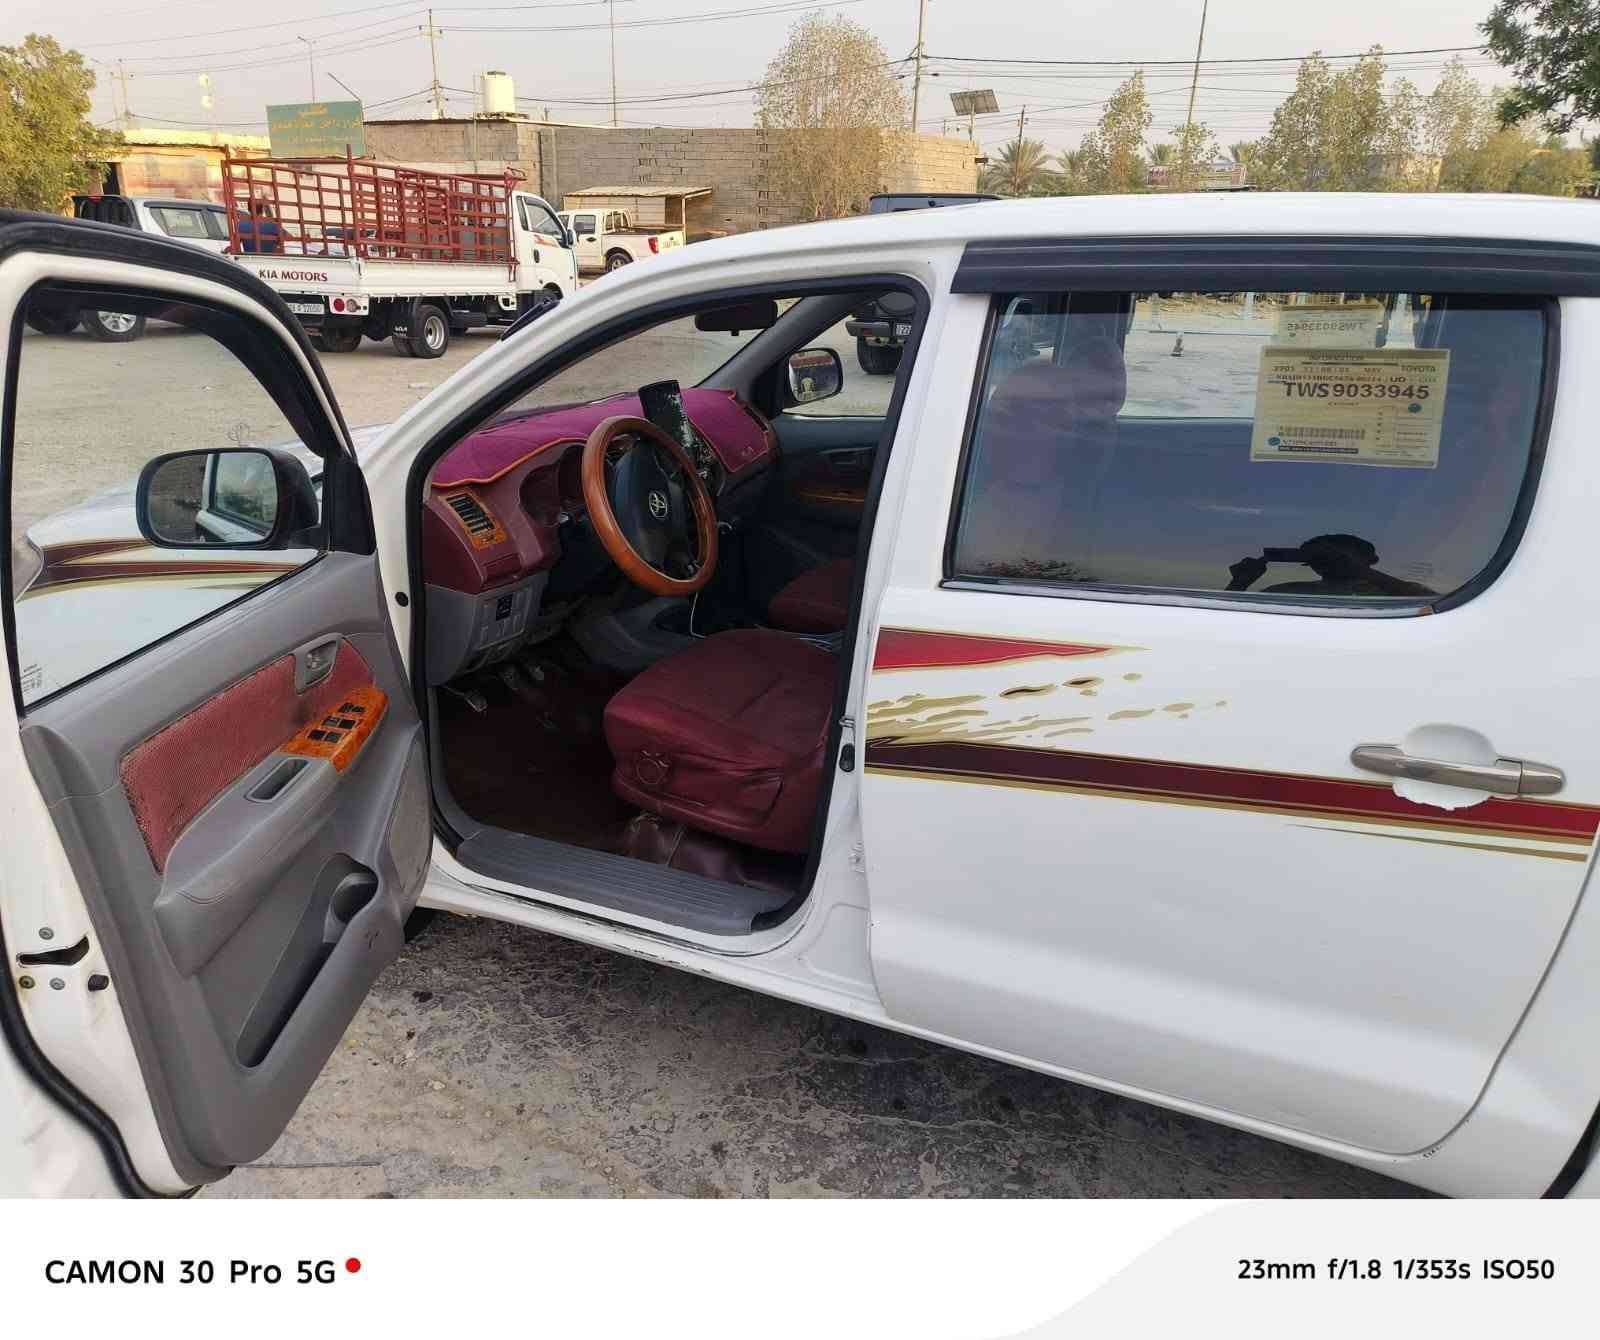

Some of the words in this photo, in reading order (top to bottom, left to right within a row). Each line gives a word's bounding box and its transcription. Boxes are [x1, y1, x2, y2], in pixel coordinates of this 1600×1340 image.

[259, 269, 278, 280] KIA
[281, 271, 328, 282] MOTORS
[1283, 382, 1430, 400] TWS9033945
